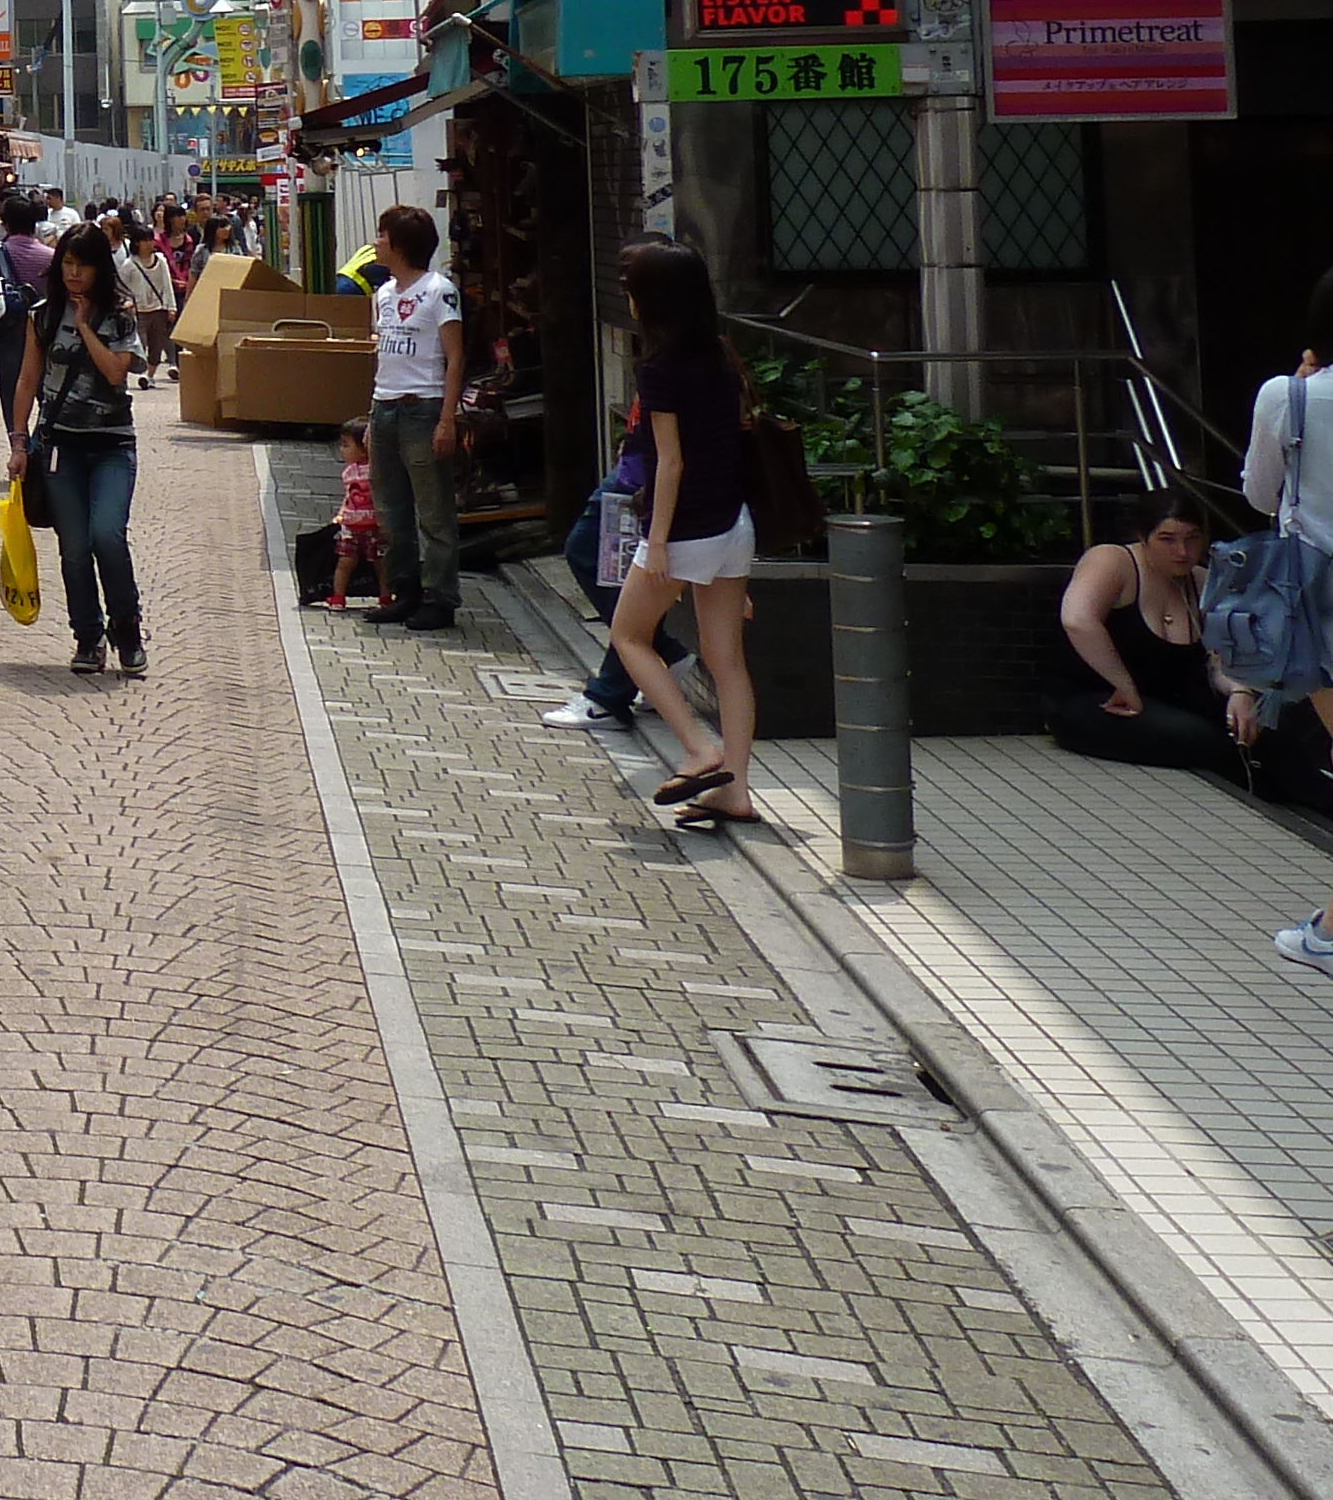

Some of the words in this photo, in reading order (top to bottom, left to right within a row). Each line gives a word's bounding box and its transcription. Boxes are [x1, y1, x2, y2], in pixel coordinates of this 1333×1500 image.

[701, 5, 807, 27] FLAVOR
[1044, 19, 1204, 45] Primetreat
[694, 52, 876, 96] 175番館
